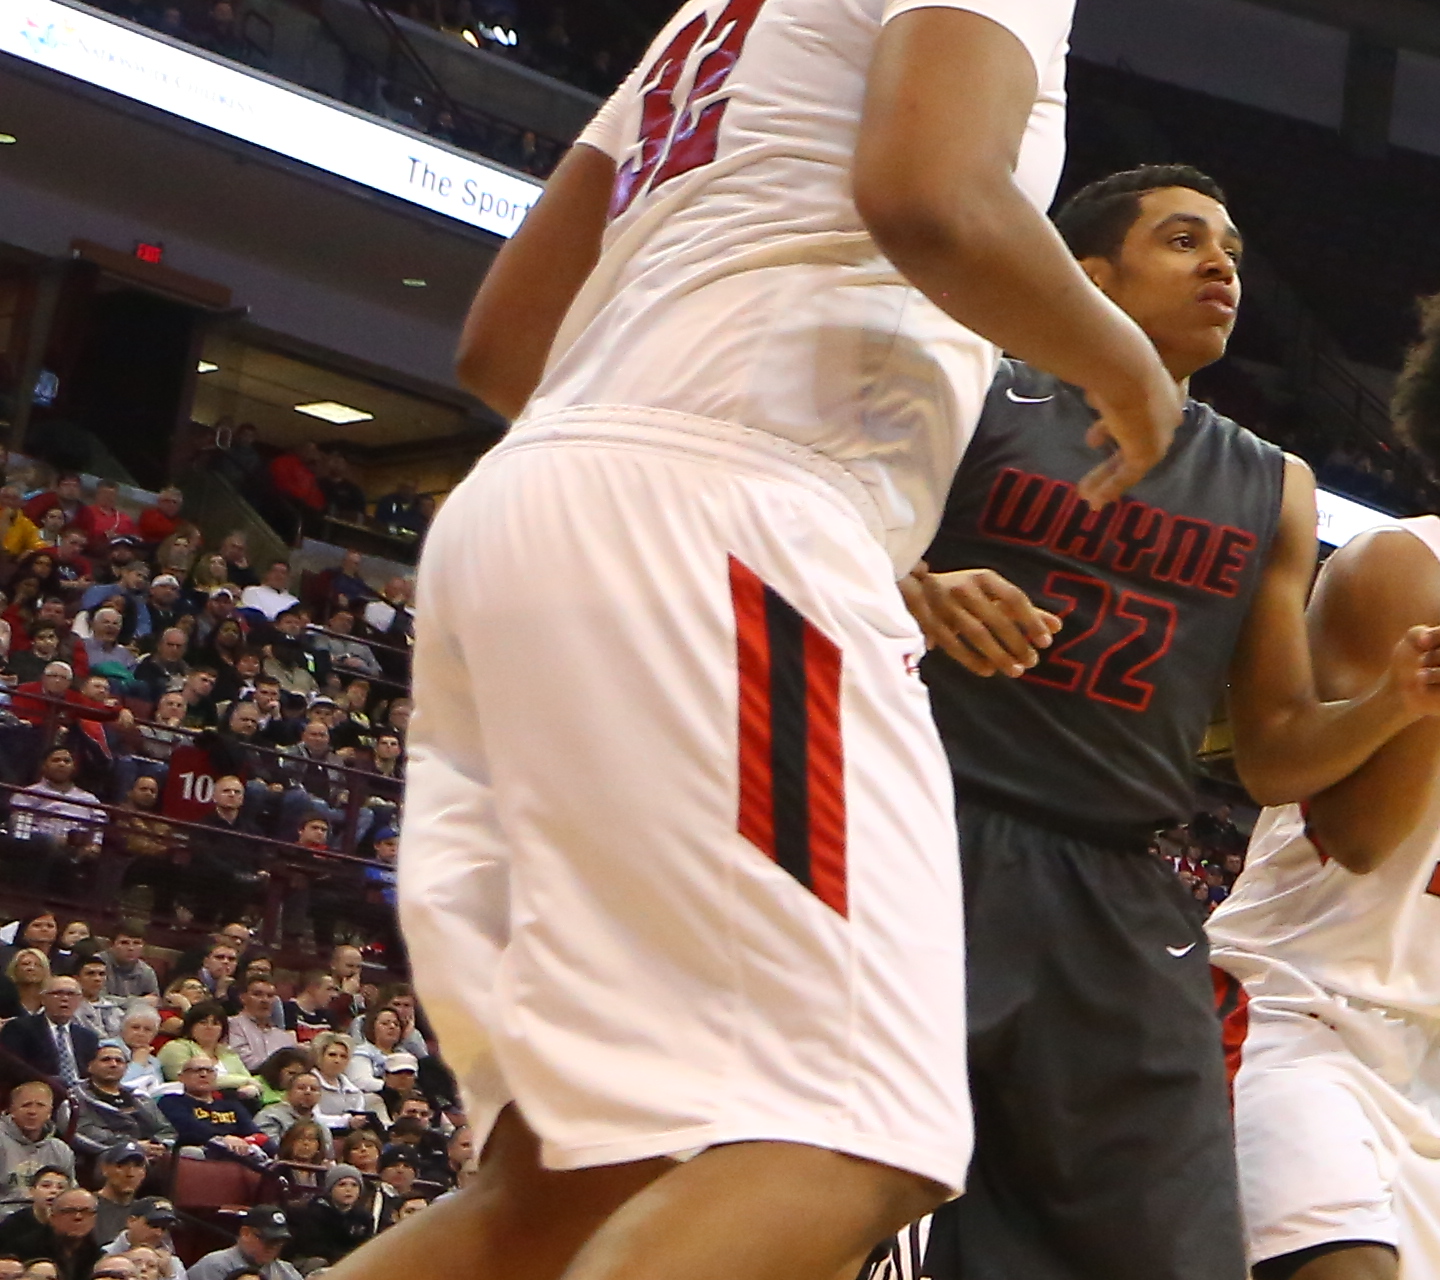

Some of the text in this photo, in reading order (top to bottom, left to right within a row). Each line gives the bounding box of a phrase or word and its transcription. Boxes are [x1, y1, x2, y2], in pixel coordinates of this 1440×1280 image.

[407, 156, 531, 224] The Sport
[981, 467, 1258, 599] WAYNE
[1020, 570, 1180, 712] 22
